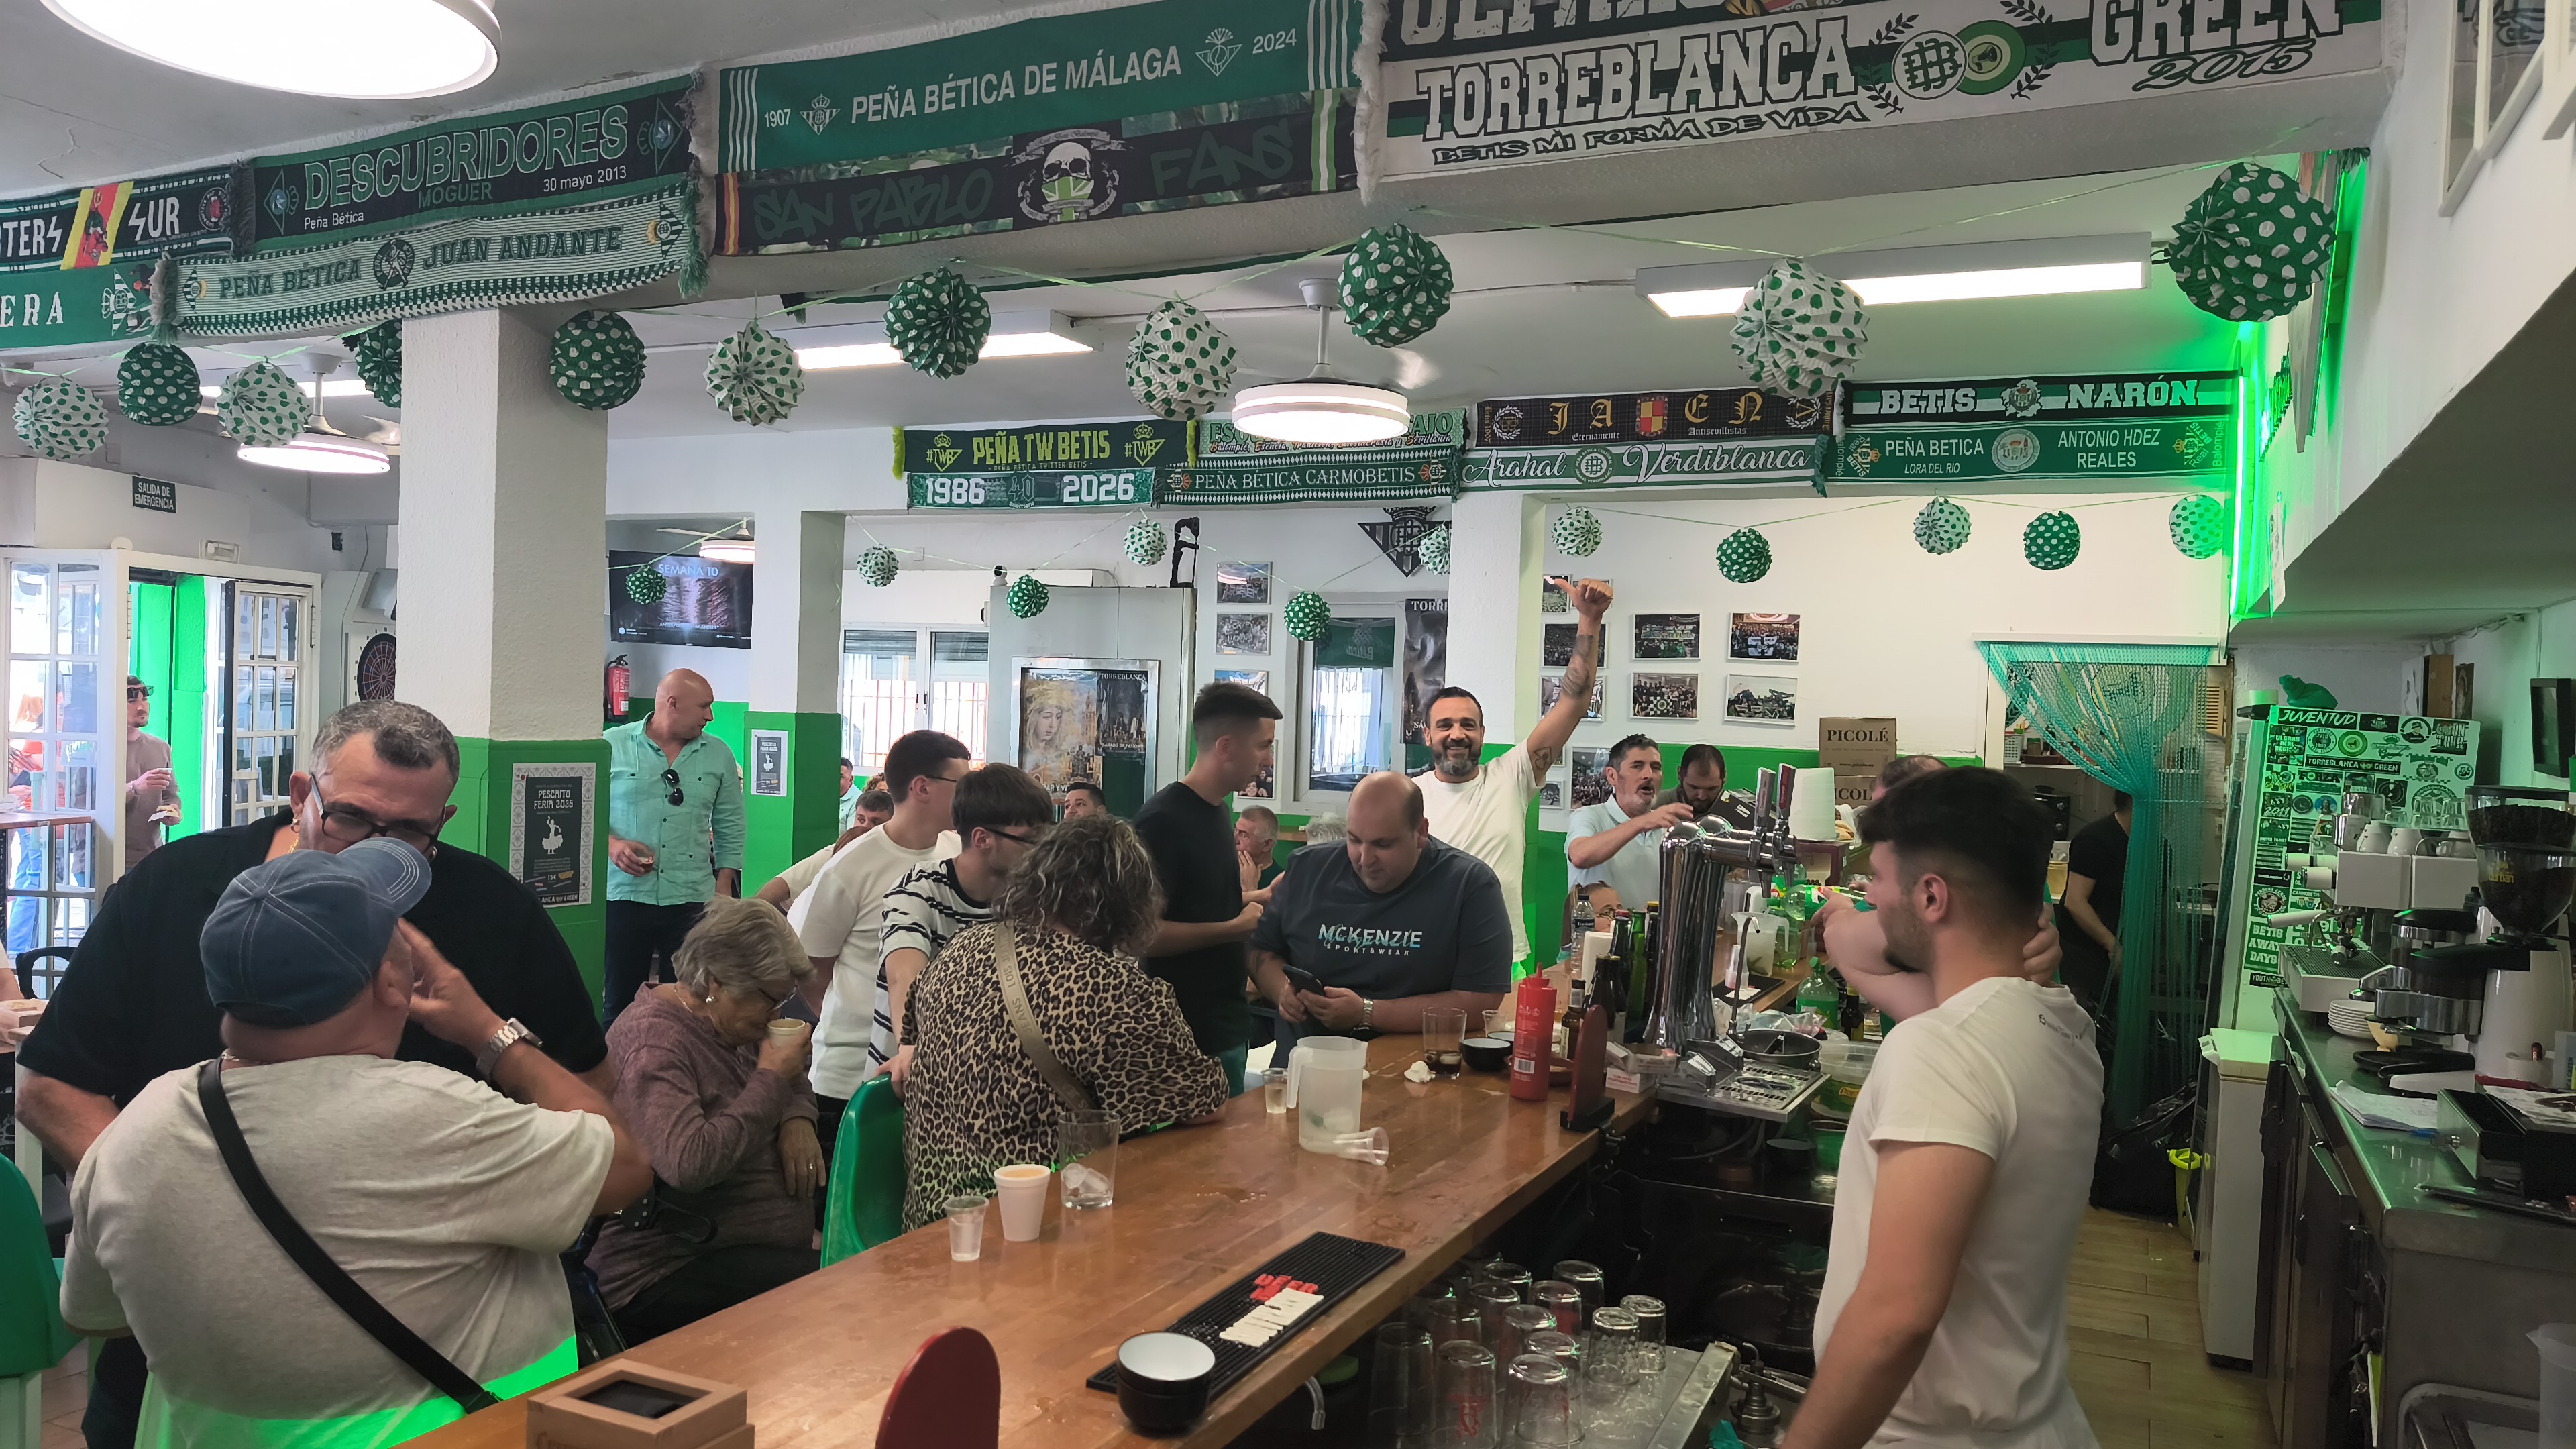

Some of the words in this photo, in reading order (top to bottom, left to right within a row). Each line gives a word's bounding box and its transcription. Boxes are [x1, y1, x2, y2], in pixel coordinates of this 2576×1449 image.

[2132, 38, 2316, 91] 2015
[764, 107, 792, 129] 1907
[851, 85, 916, 125] PEÑA
[924, 68, 1016, 114] BÉTICA
[1024, 63, 1059, 96] DE
[1065, 45, 1182, 90] MÁLAGA
[1252, 29, 1297, 55] 2024
[1416, 16, 1858, 142] TORREBLANCA
[1433, 140, 1530, 165] BETIS
[1532, 131, 1576, 156] MI
[1585, 117, 1705, 150] FORMA
[1705, 114, 1765, 137] DE
[1763, 102, 1871, 129] VIDA
[304, 105, 629, 210] DESCUBRIDORES
[543, 178, 557, 193] 30
[559, 172, 594, 192] mayo
[598, 166, 628, 184] 2013
[752, 186, 835, 244] SAN
[849, 168, 994, 233] PABLO
[1150, 119, 1293, 197] FANS
[417, 182, 494, 210] MOGUER
[0, 215, 63, 258] TERS
[128, 197, 180, 241] SUR
[304, 213, 328, 230] Peña
[333, 210, 364, 228] Bética
[219, 271, 274, 300] PEÑA
[283, 256, 362, 293] BÉTICA
[423, 237, 496, 269] JUAN
[499, 223, 624, 260] ANDANTE
[1880, 388, 1976, 415] BETIS
[2068, 375, 2199, 409] NARÓN
[1405, 413, 1453, 436] AJO
[2190, 422, 2212, 444] BETIS
[972, 431, 1019, 464] PEÑA
[1024, 432, 1054, 461] TW
[1058, 429, 1110, 460] BETIS
[1572, 431, 1620, 441] Eternamente
[1849, 435, 1866, 452] Real
[1886, 436, 1925, 458] PEÑA
[1929, 438, 1984, 456] BETICA
[2058, 430, 2120, 448] ANTONIO
[2123, 428, 2161, 446] HDEZ
[2212, 421, 2226, 467] Balompié
[1040, 461, 1065, 469] TWITTER
[1462, 449, 1567, 488] Arahal
[1622, 442, 1811, 484] Verdiblanca
[1835, 441, 1847, 476] alompié
[1847, 455, 1866, 477] BETIS
[1904, 463, 1922, 474] LORA
[1923, 463, 1943, 474] DEL
[1945, 463, 1960, 474] RIO
[2077, 451, 2137, 468] REALES
[2189, 448, 2209, 468] Real
[926, 478, 985, 504] 1986
[1008, 474, 1034, 502] 40
[1063, 473, 1135, 503] 2026
[1195, 471, 1237, 490] PEÑA
[1242, 469, 1300, 488] BÉTICA
[1305, 466, 1415, 486] CARMOBETIS
[138, 482, 160, 496] SALIDA
[162, 486, 170, 497] DE
[134, 493, 174, 510] EMERGENCIA
[658, 564, 704, 576] SEMANA
[706, 566, 718, 577] 10
[2279, 709, 2357, 725] JUVENTUD
[1827, 727, 1888, 742] PICOLÉ
[2308, 757, 2359, 769] TORREBLANCA
[2374, 763, 2398, 771] GREEN
[534, 800, 553, 809] FERIA
[555, 799, 574, 808] 2026
[539, 790, 570, 799] PESCAITO
[1835, 788, 1872, 801] ICOL
[1318, 924, 1422, 948] MCKENZIE
[2253, 924, 2284, 938] BETIS
[1326, 943, 1409, 956] SPORTSWEAR
[2250, 951, 2278, 965] DAYS
[2252, 974, 2271, 983] YOUTH
